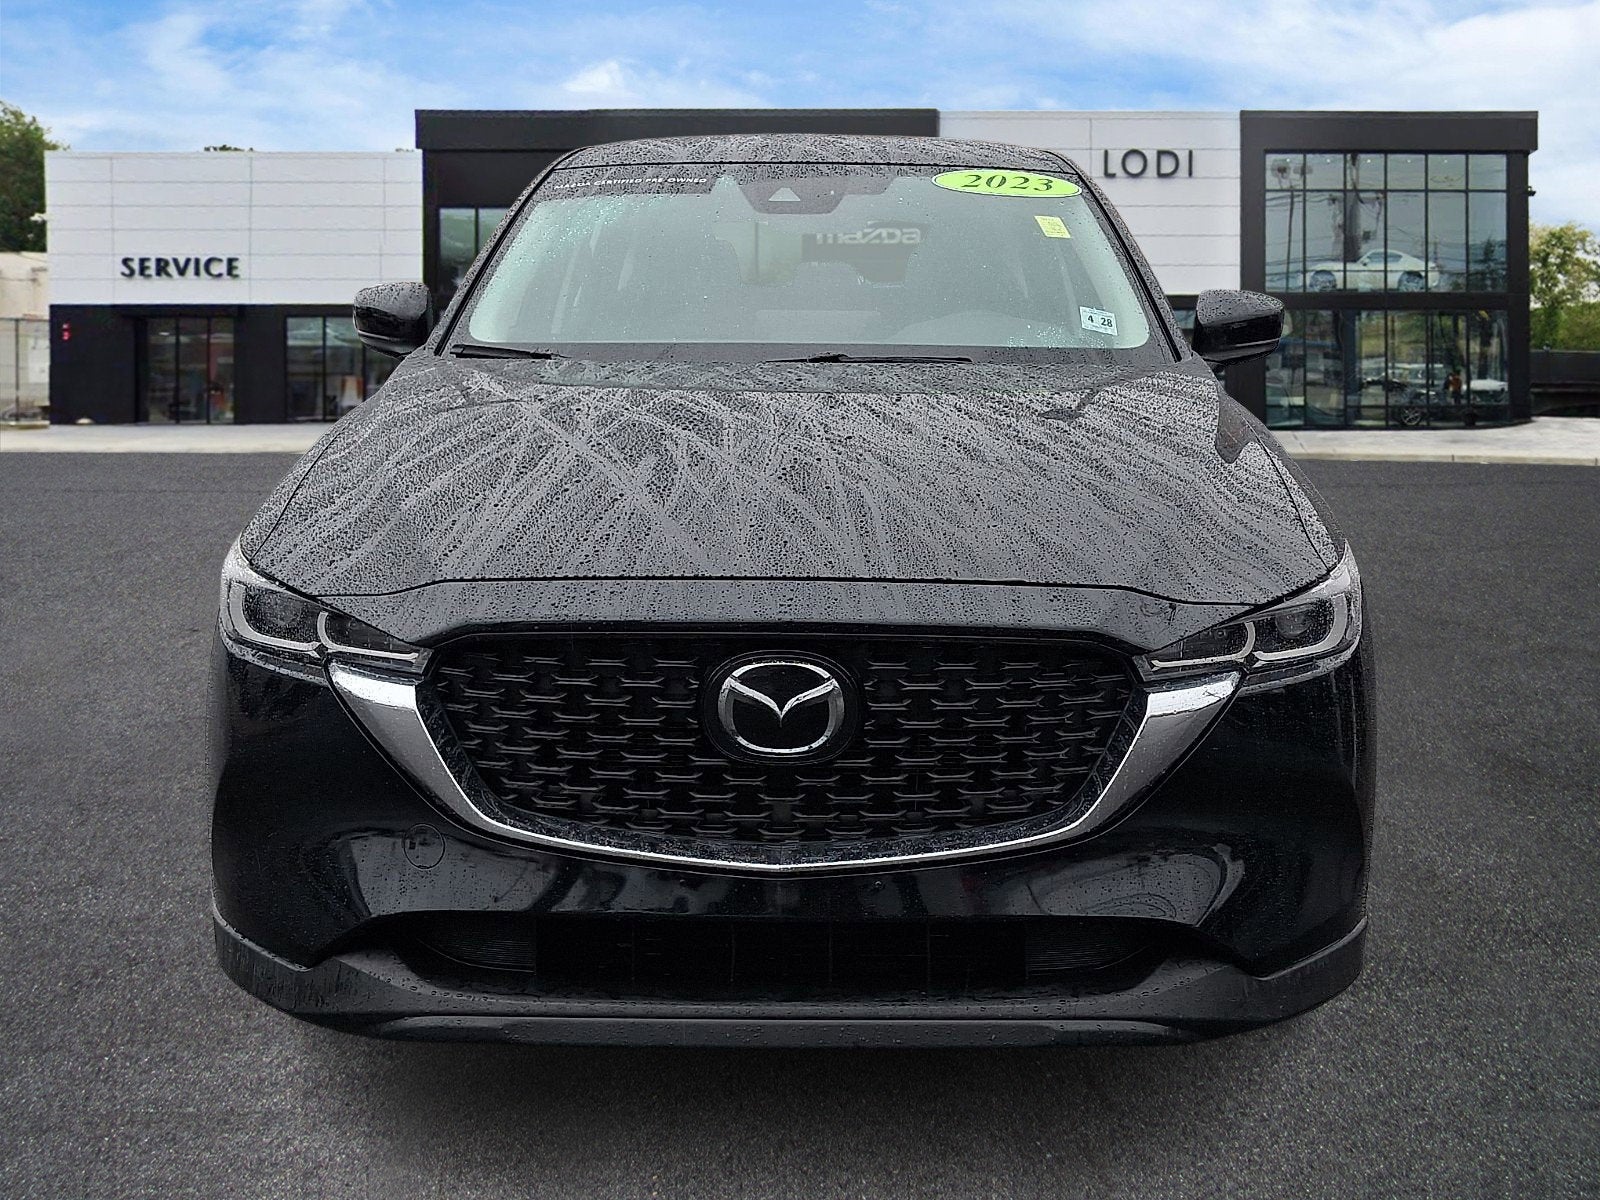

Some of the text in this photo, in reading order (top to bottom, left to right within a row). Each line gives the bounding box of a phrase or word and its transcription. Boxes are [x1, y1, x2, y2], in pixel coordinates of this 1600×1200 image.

[1103, 148, 1193, 178] LODI
[594, 178, 642, 186] CERTIFIED
[961, 174, 1054, 191] 2023
[120, 256, 240, 278] SERVICE
[1087, 315, 1113, 328] 4 28
